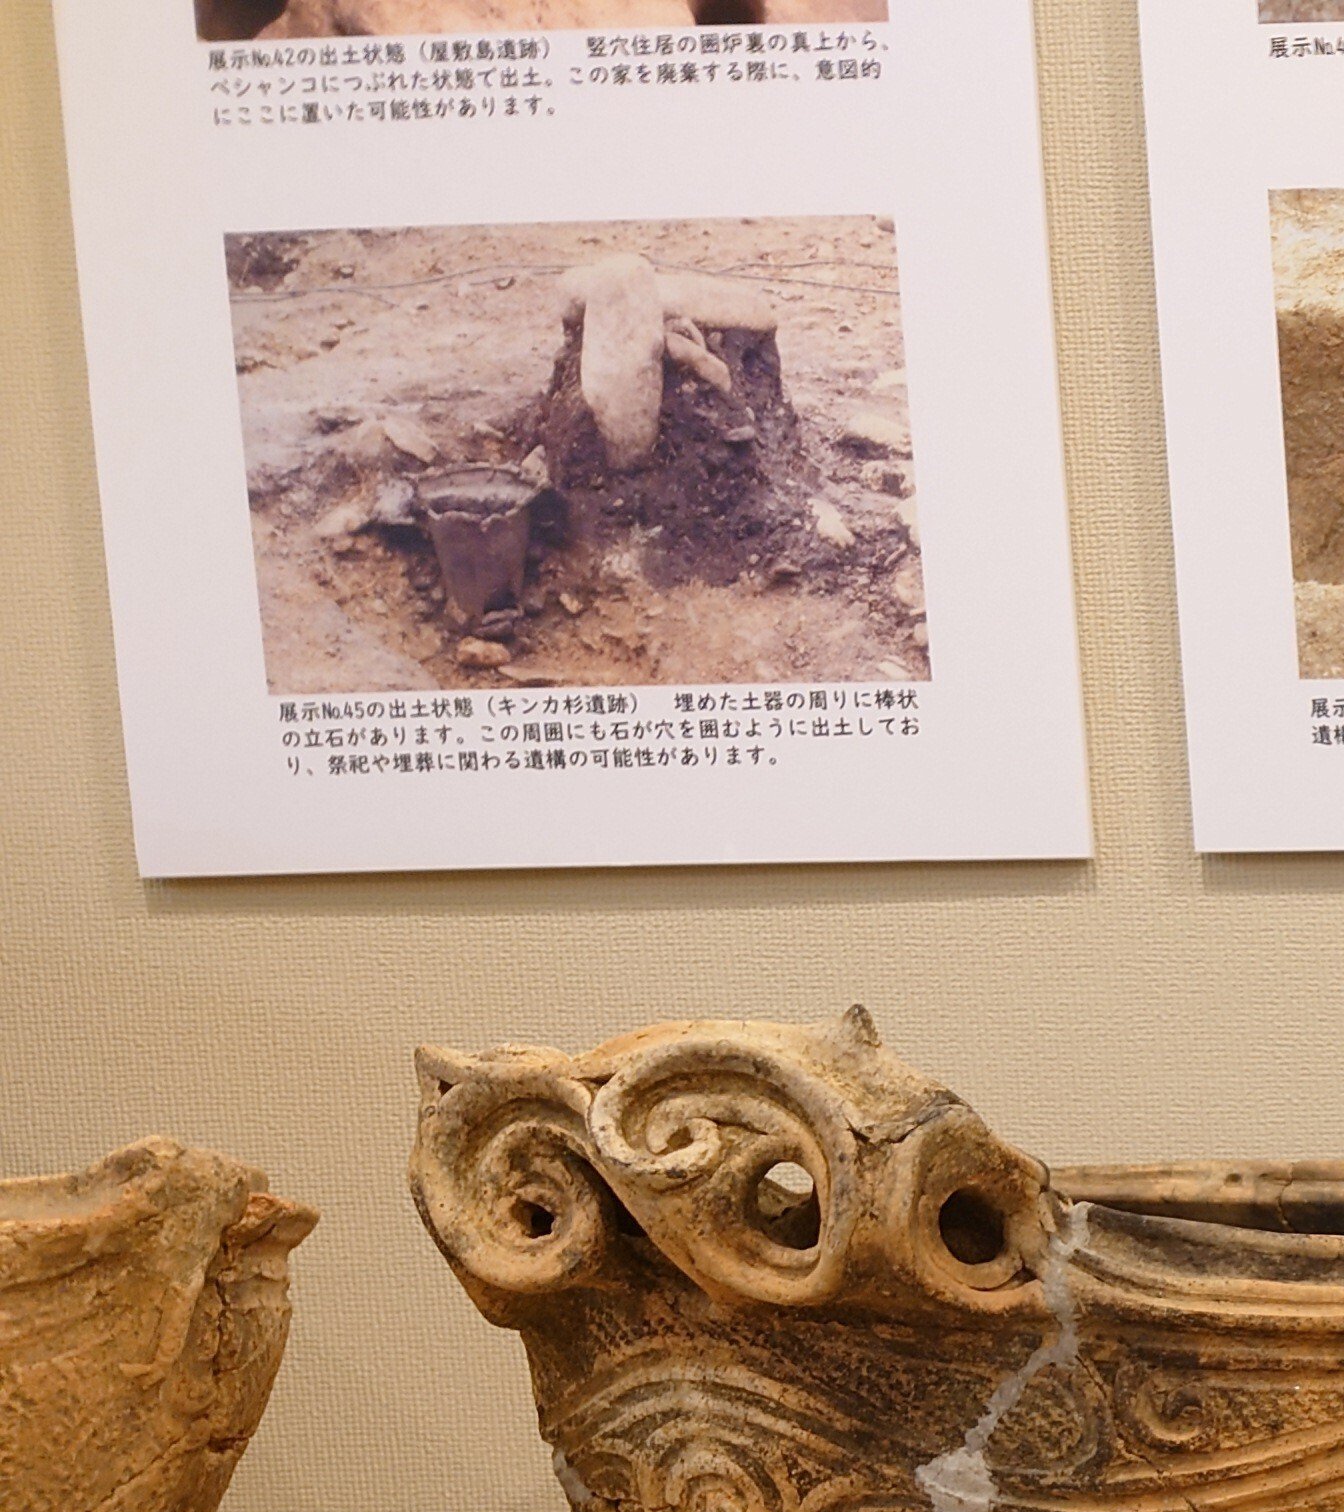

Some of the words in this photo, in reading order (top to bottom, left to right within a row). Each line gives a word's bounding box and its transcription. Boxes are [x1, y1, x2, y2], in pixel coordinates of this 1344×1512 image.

[674, 689, 920, 713] 埋めた土器の周りに棒状
